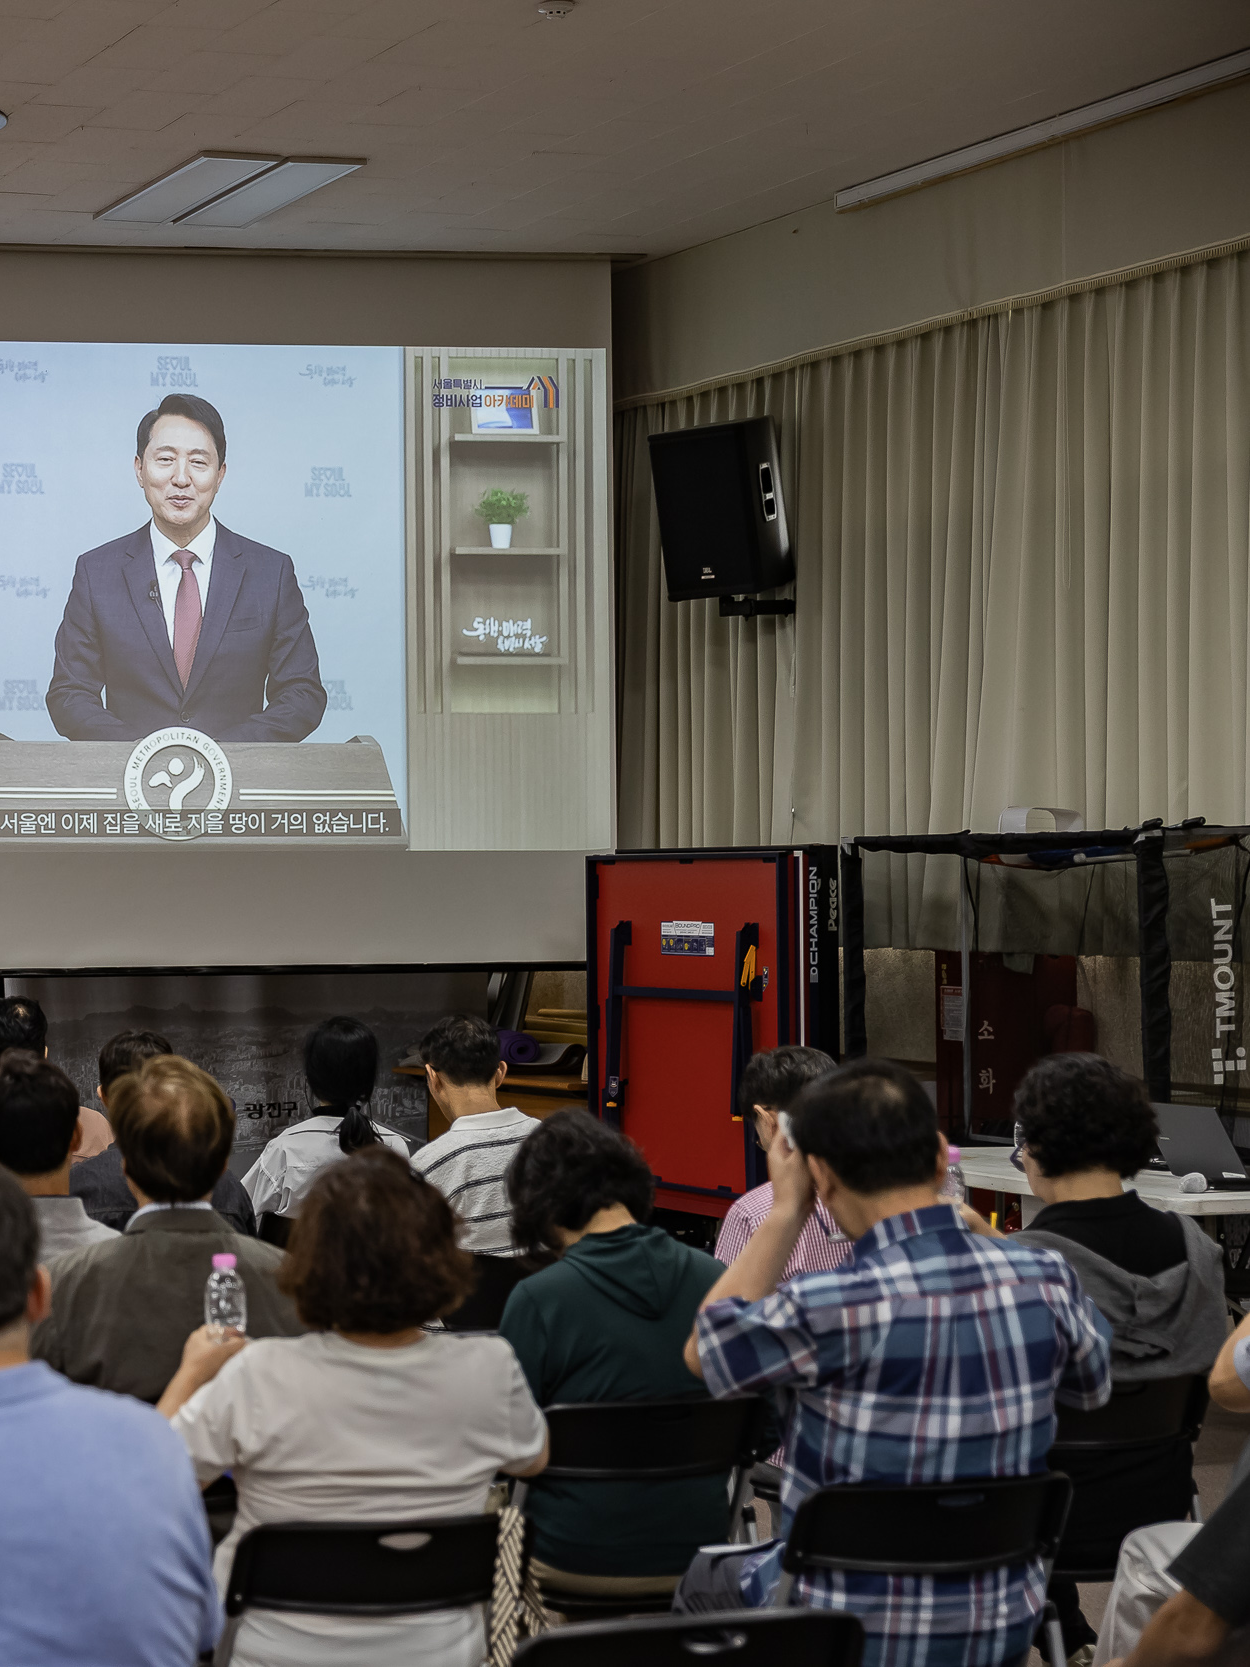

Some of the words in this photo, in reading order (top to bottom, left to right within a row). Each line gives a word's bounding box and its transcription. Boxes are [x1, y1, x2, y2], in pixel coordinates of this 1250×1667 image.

[432, 378, 483, 390] 서울특별시
[432, 394, 483, 408] 정비사업
[484, 394, 534, 409] 아카데미
[131, 732, 200, 771] METROPOLITAN
[0, 812, 56, 835] 서울엔
[61, 812, 98, 835] 이제
[103, 812, 141, 835] 집을
[145, 812, 183, 834] 새로
[187, 812, 225, 834] 지을
[229, 812, 266, 834] 땅이
[270, 812, 307, 834] 거의
[312, 812, 390, 834] 없습니다.
[1210, 898, 1235, 1038] TMOUNT
[243, 1101, 298, 1119] 광진구
